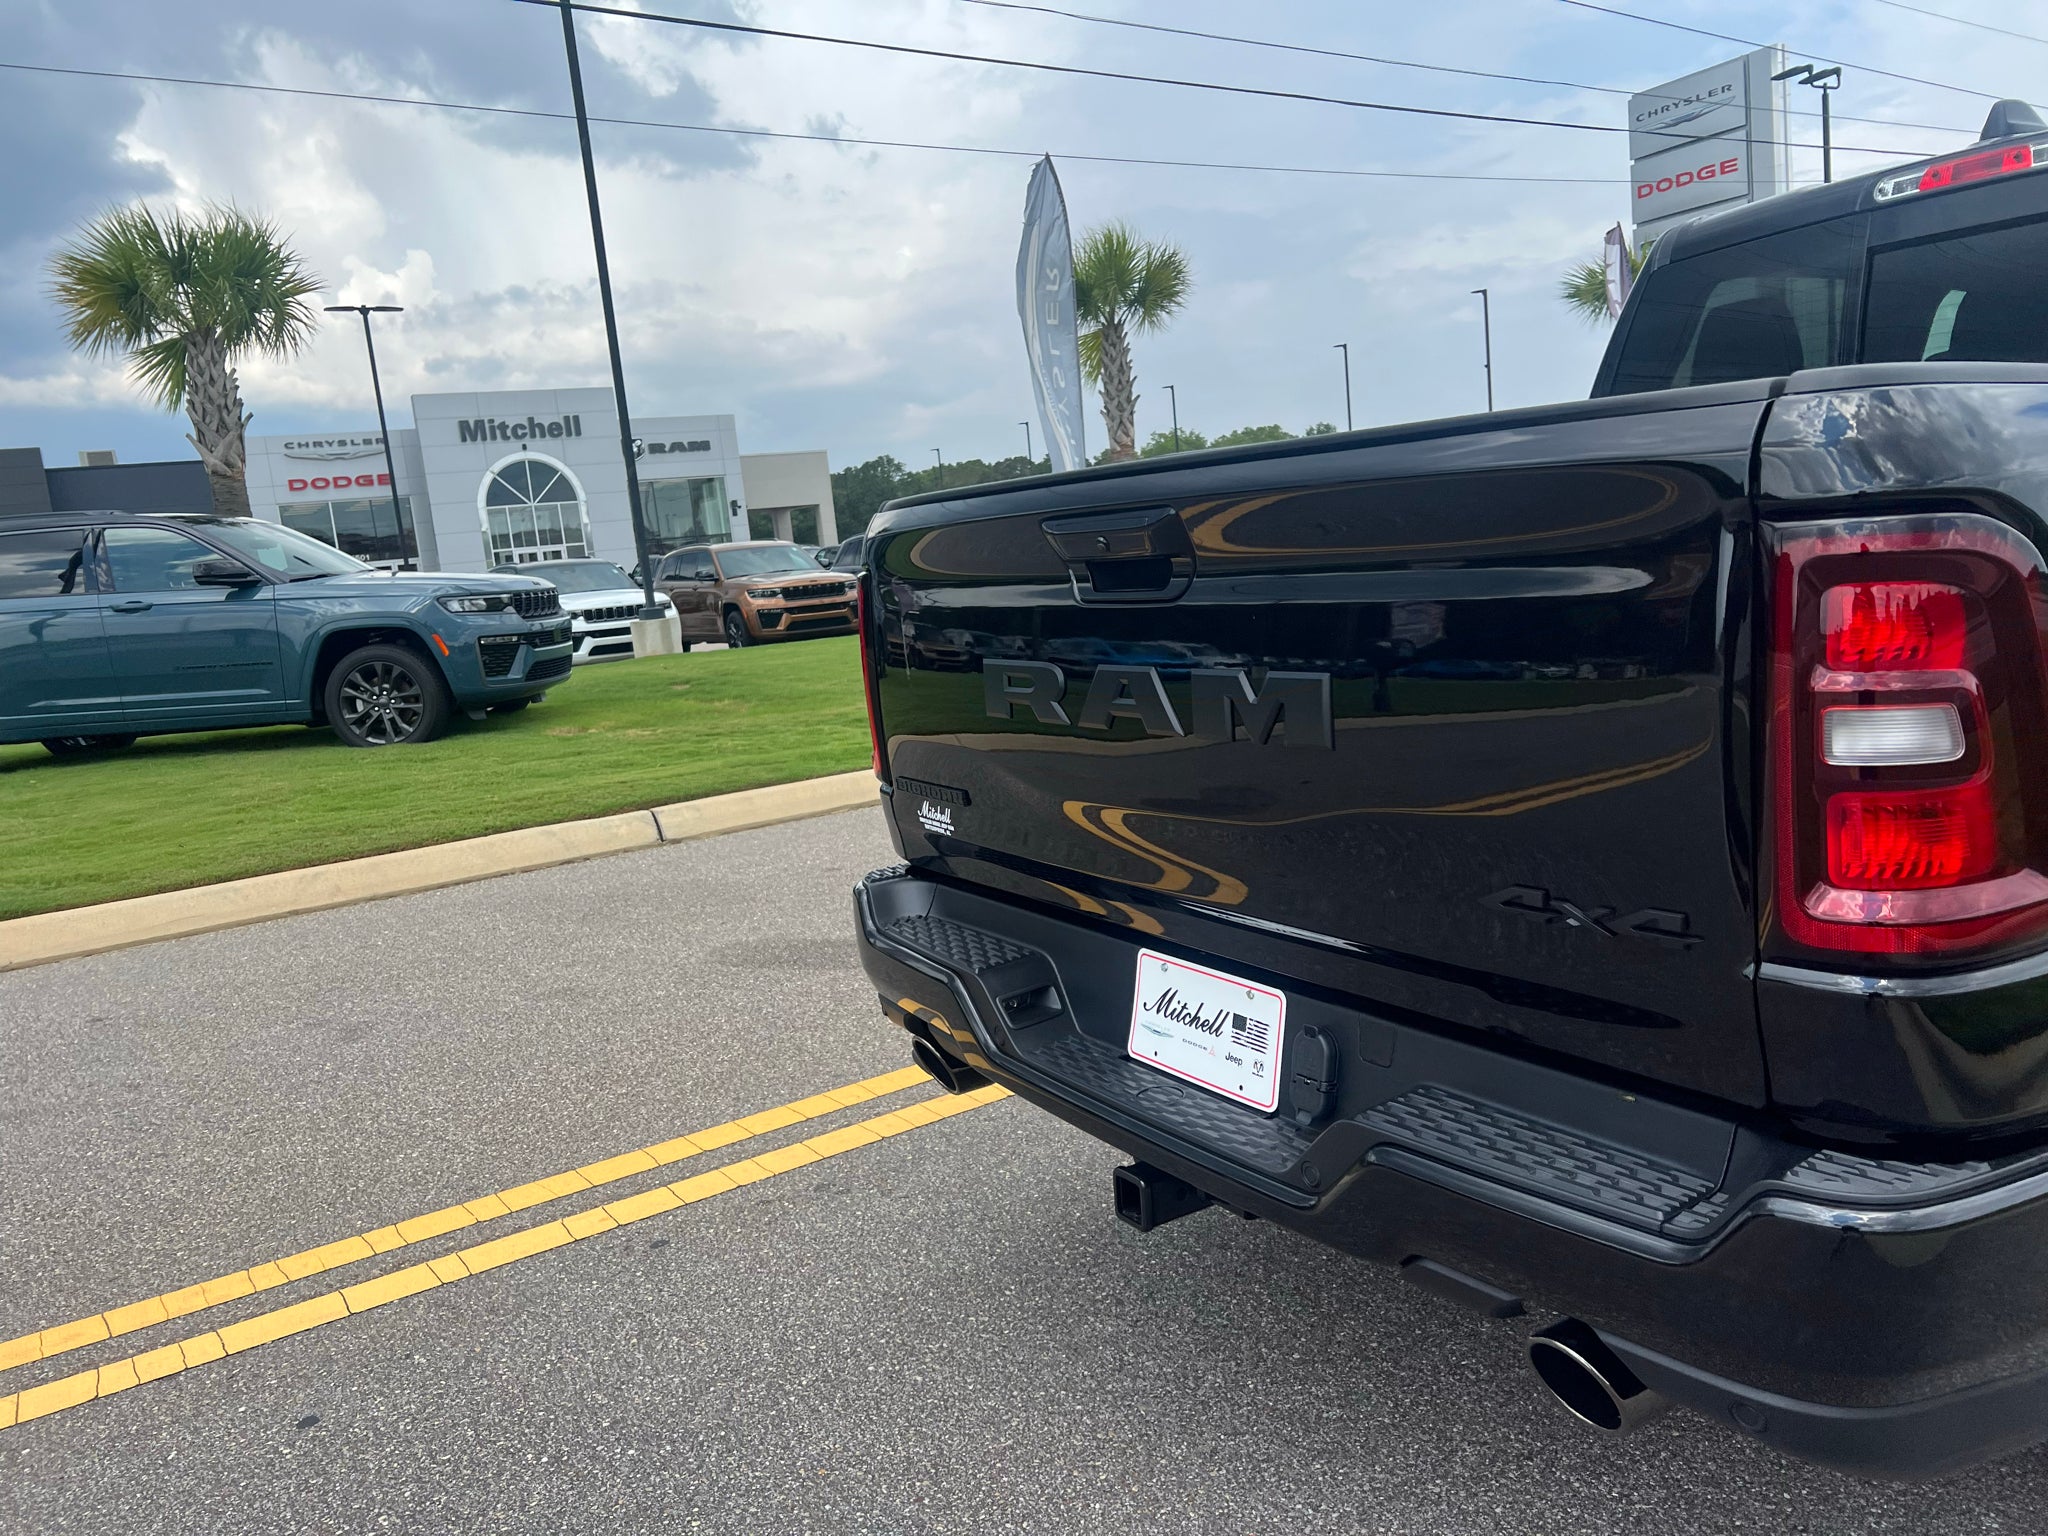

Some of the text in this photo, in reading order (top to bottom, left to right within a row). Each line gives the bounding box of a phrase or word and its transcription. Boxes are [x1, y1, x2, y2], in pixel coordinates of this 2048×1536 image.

[1636, 84, 1733, 122] CHRYSLER
[1637, 157, 1739, 199] DODGE
[458, 415, 582, 442] Mitchell
[648, 440, 711, 454] RAM
[288, 473, 391, 491] DODGE
[983, 659, 1335, 749] RAM
[917, 800, 951, 823] Mitchell
[1143, 987, 1230, 1037] Mitchell
[1225, 1052, 1243, 1067] Jeep
